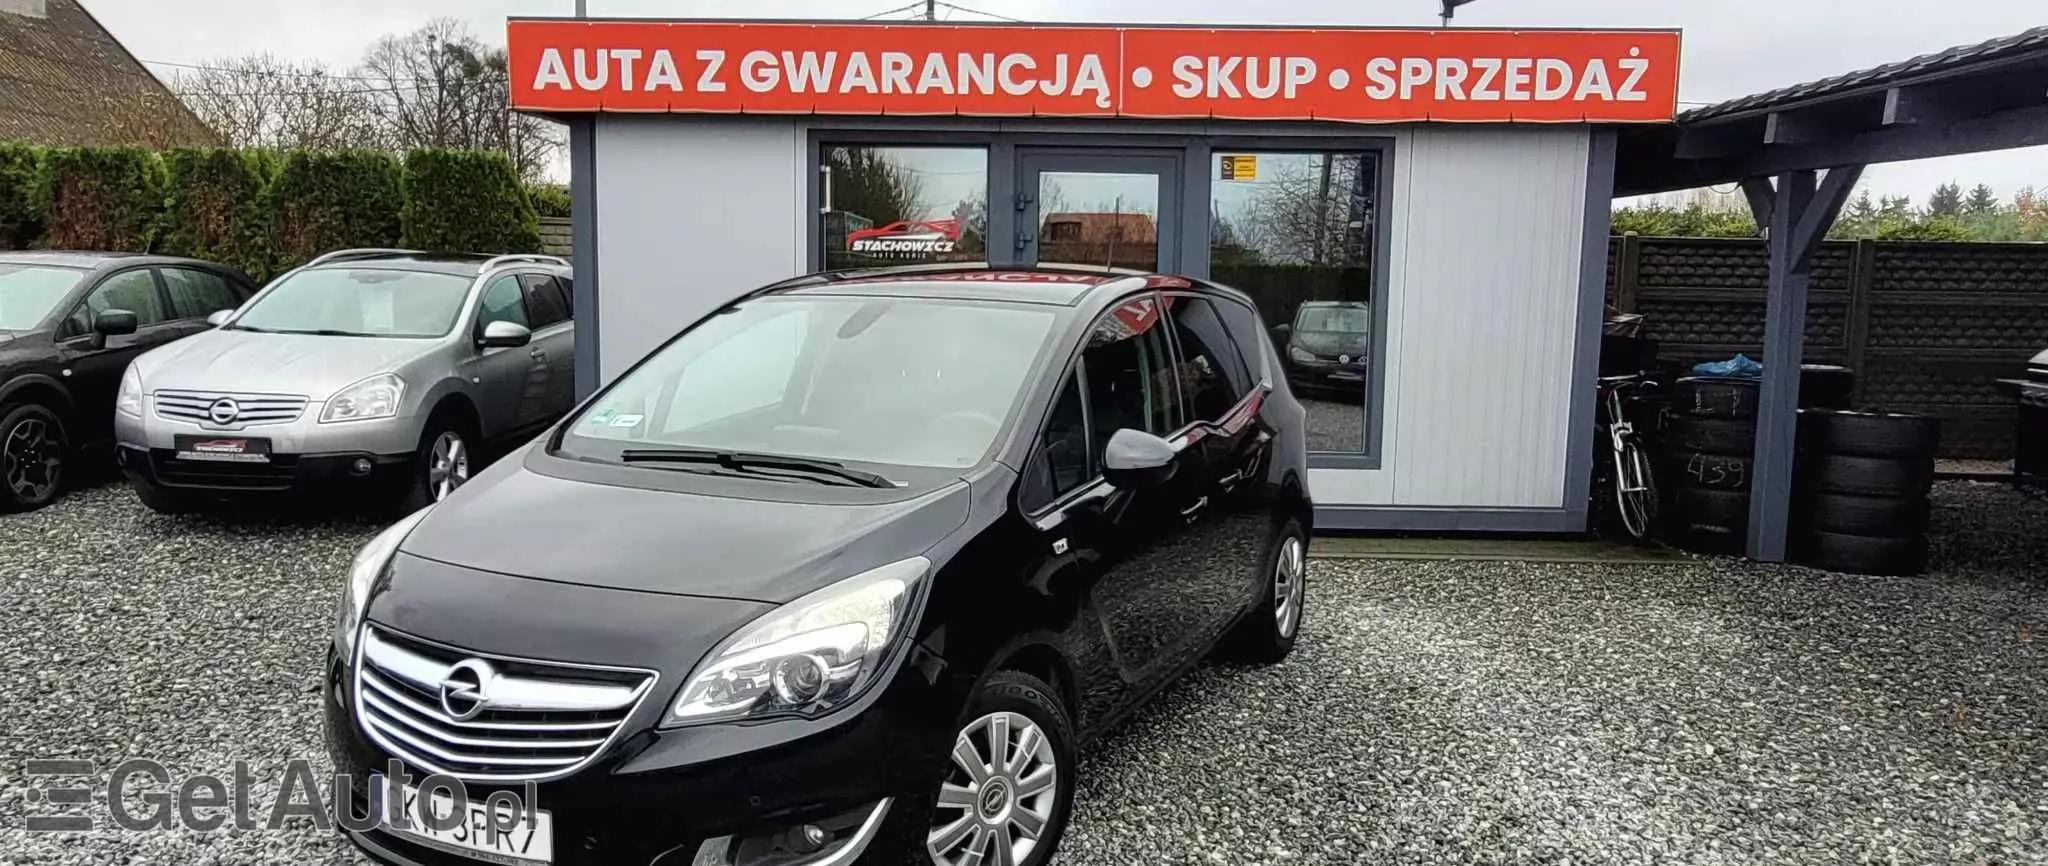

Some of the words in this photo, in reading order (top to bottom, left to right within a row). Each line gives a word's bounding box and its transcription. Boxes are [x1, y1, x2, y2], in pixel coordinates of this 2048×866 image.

[532, 47, 684, 92] AUTA
[697, 50, 727, 92] Z
[739, 50, 1111, 108] GWARANCJĄ
[1171, 54, 1317, 99] SKUP
[1365, 46, 1650, 101] SPRZEDAŻ
[852, 240, 955, 252] STACHOWICZ
